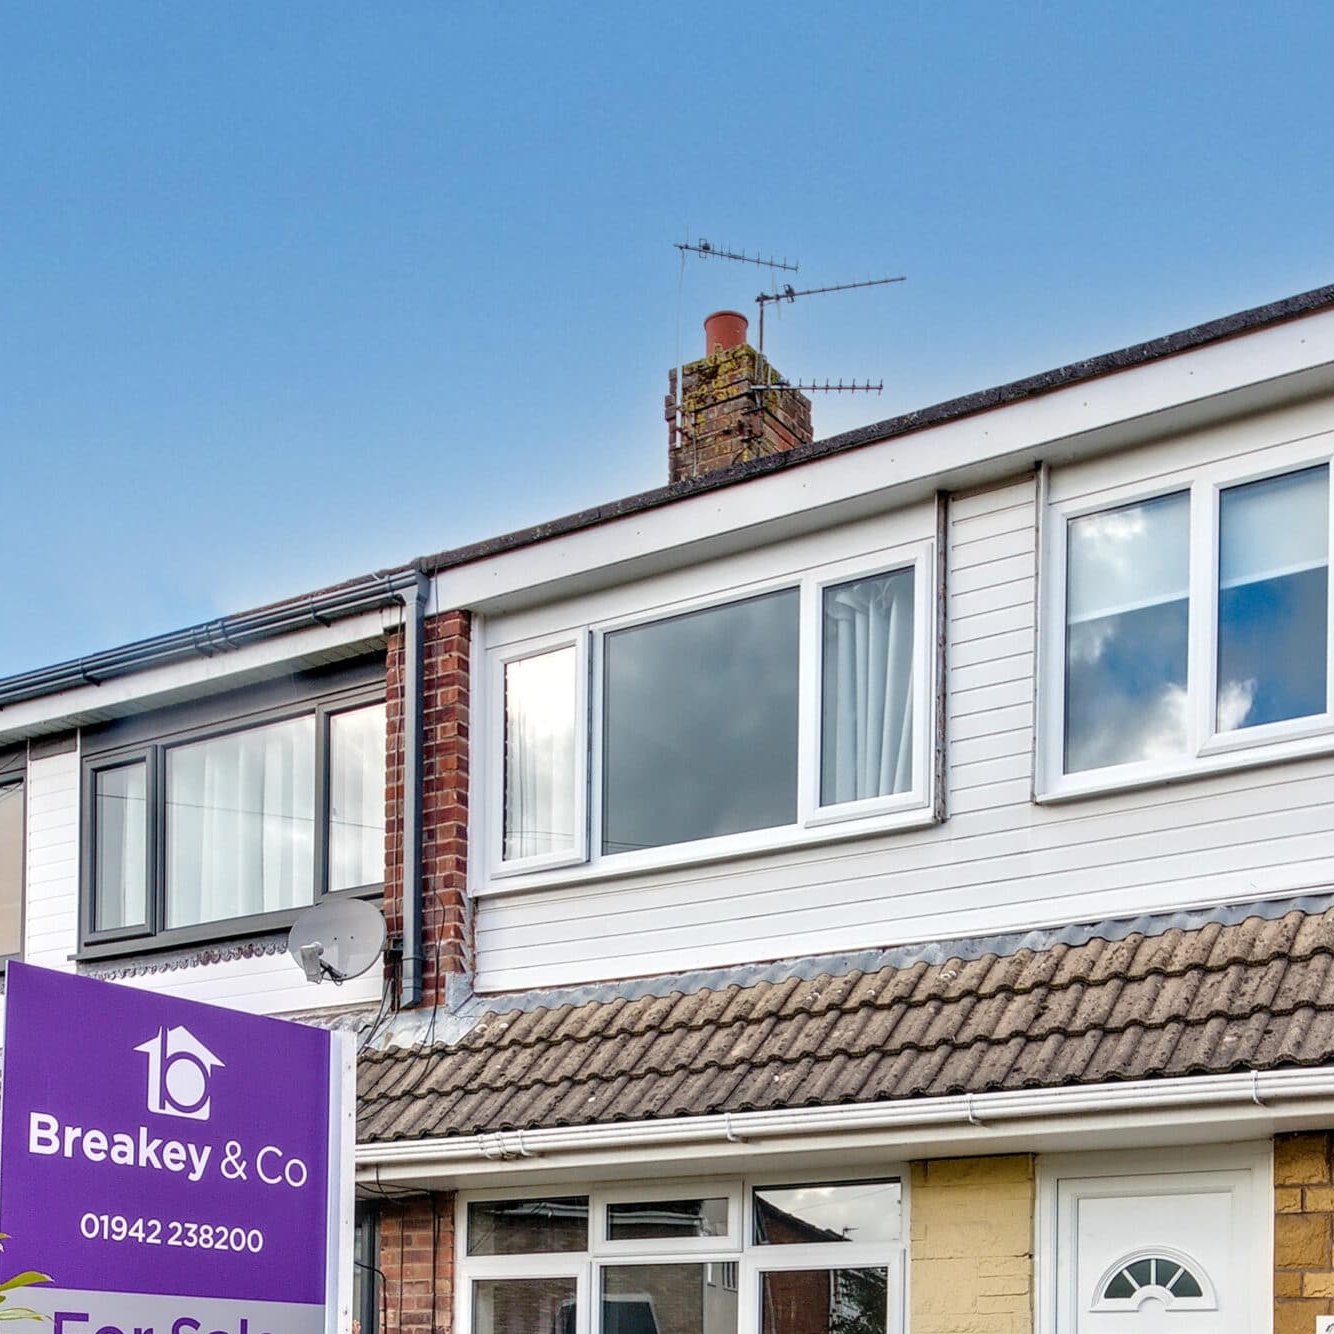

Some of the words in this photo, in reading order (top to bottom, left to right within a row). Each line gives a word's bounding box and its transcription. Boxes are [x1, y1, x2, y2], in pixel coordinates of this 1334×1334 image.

[29, 1111, 212, 1182] Breakey
[220, 1140, 247, 1181] &
[256, 1145, 308, 1188] Co
[80, 1212, 162, 1244] 01942
[167, 1221, 264, 1253] 238200
